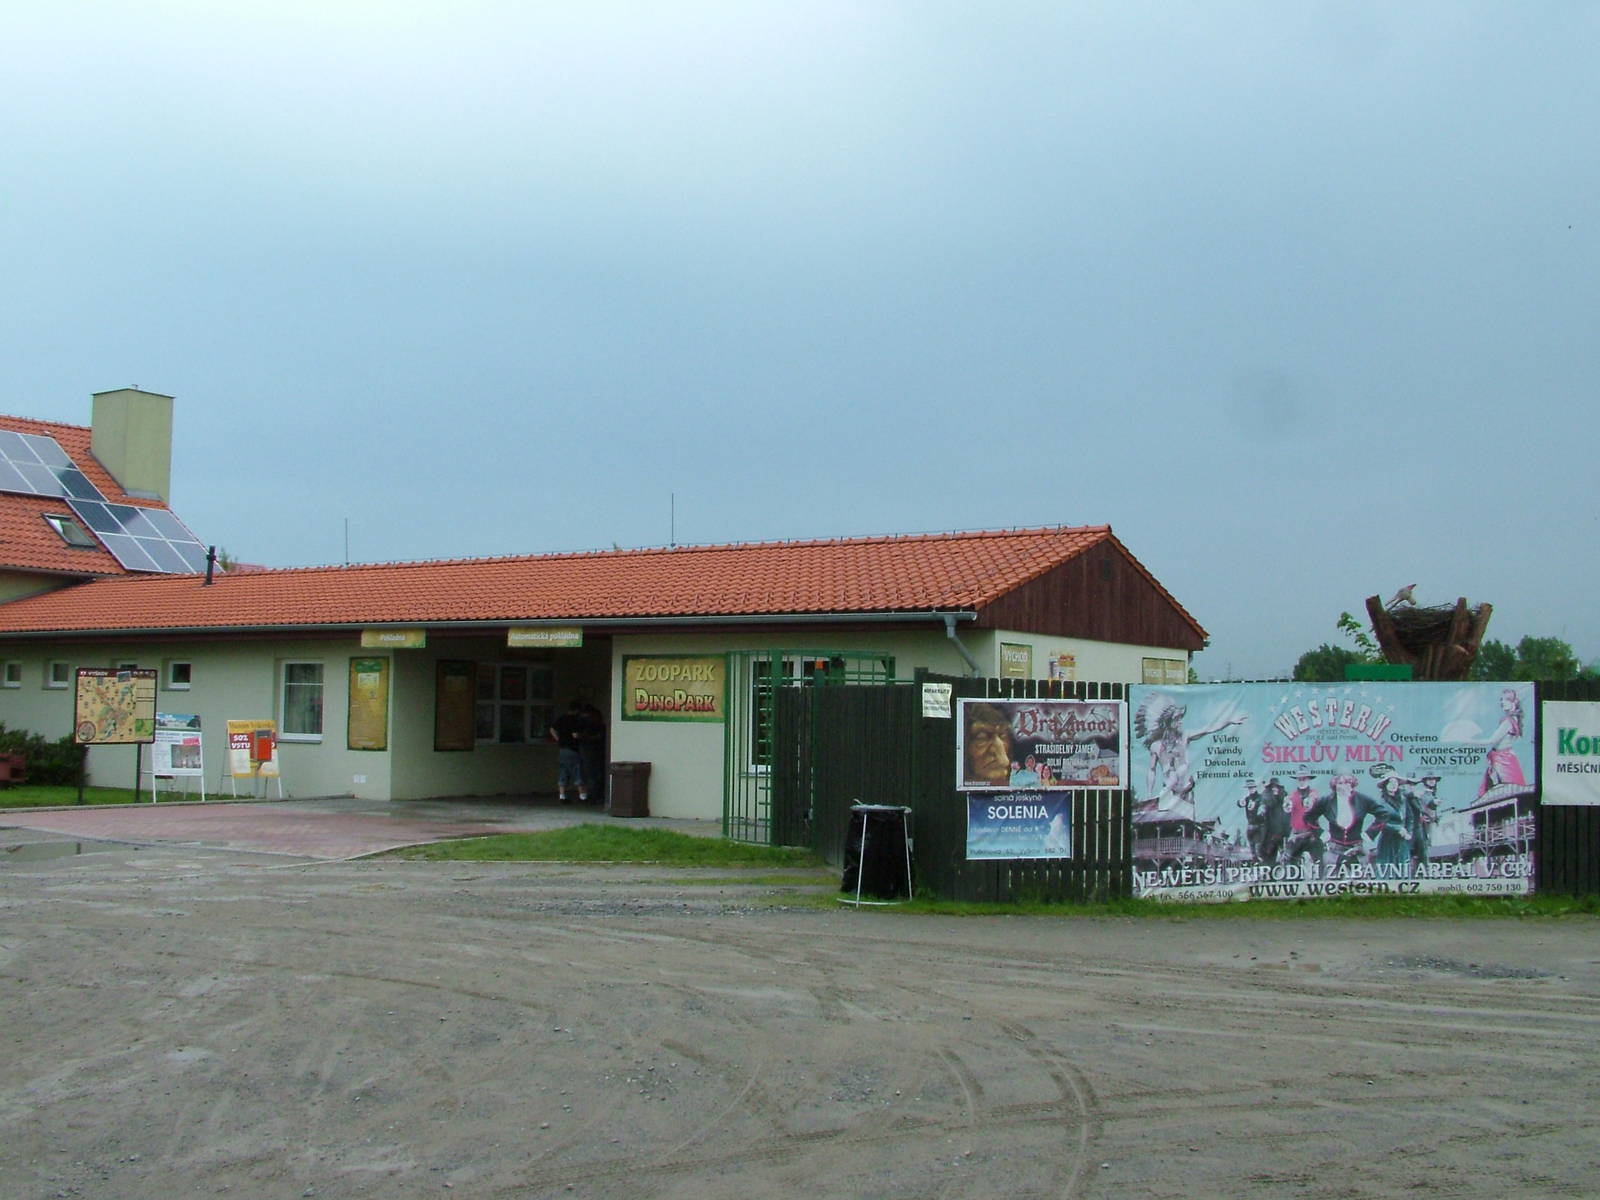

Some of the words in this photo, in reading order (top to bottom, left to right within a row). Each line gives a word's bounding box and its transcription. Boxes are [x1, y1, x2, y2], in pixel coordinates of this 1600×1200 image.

[636, 664, 715, 682] ZOOPARK
[1274, 697, 1391, 741] WESTERN
[1213, 734, 1240, 744] Výlety
[1390, 732, 1438, 742] Otevřeno
[1207, 746, 1242, 755] Víkendy
[1262, 740, 1340, 763] ŠIKLŮV
[1345, 740, 1404, 762] MLÝN
[1409, 745, 1487, 756] červenec-srpen
[1204, 758, 1246, 767] Dovolená
[1420, 756, 1446, 765] NON
[1449, 755, 1481, 765] STOP
[1197, 770, 1230, 779] Firemní
[1233, 770, 1254, 778] akce
[987, 805, 1049, 819] SOLENIA
[1132, 864, 1223, 888] NEJVĚTŠÍ
[1226, 861, 1321, 883] PŘÍRODNÍ
[1326, 859, 1410, 880] ZÁBAVNÍ
[1415, 860, 1477, 879] AREÁL
[1481, 863, 1495, 878] V
[1250, 880, 1421, 897] www.western.cz
[1466, 883, 1483, 892] 602
